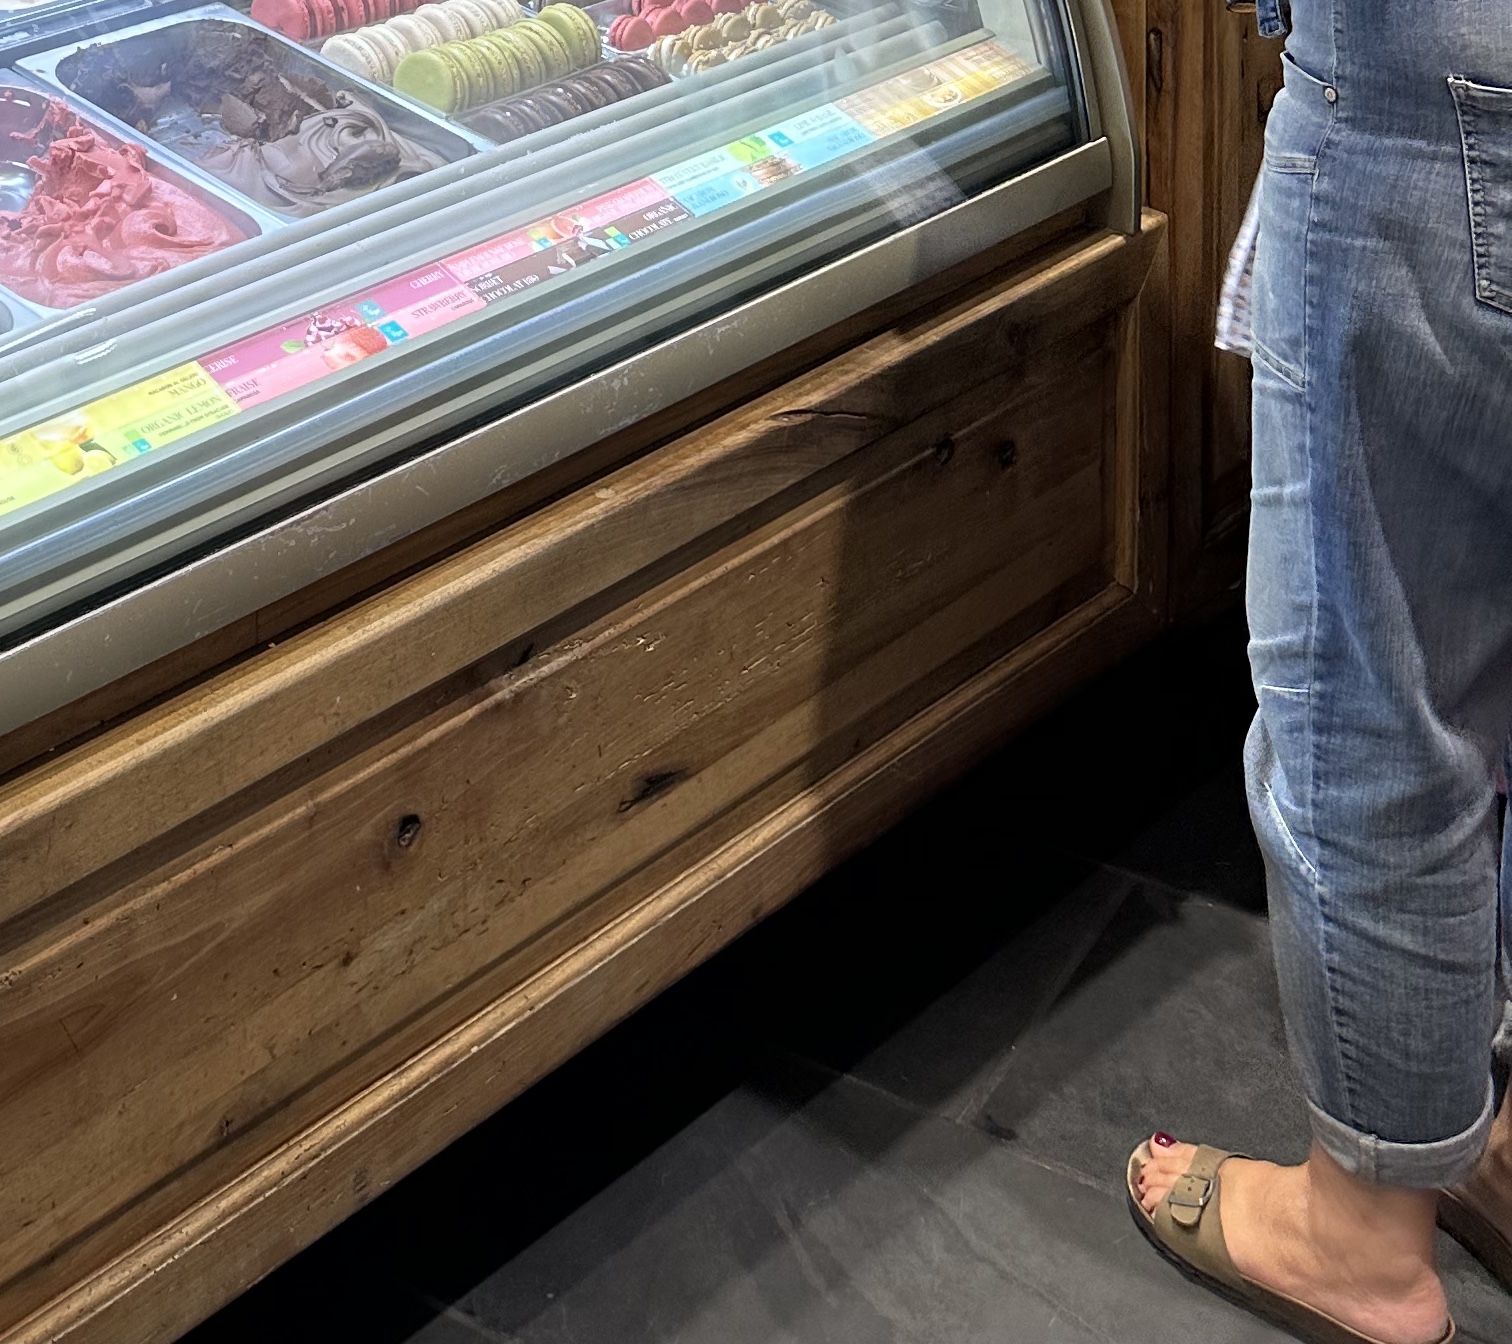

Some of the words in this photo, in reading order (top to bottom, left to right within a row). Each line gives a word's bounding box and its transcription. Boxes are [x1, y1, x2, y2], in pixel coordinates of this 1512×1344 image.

[628, 217, 674, 240] CHOCOLATE
[409, 269, 445, 290] CHERRY
[411, 289, 468, 319] STRAWBERRY
[203, 354, 239, 374] CERISE
[168, 377, 207, 399] MANGO
[225, 378, 261, 398] FRAISE
[140, 409, 184, 434] ORGANIC
[185, 394, 223, 416] LEMON
